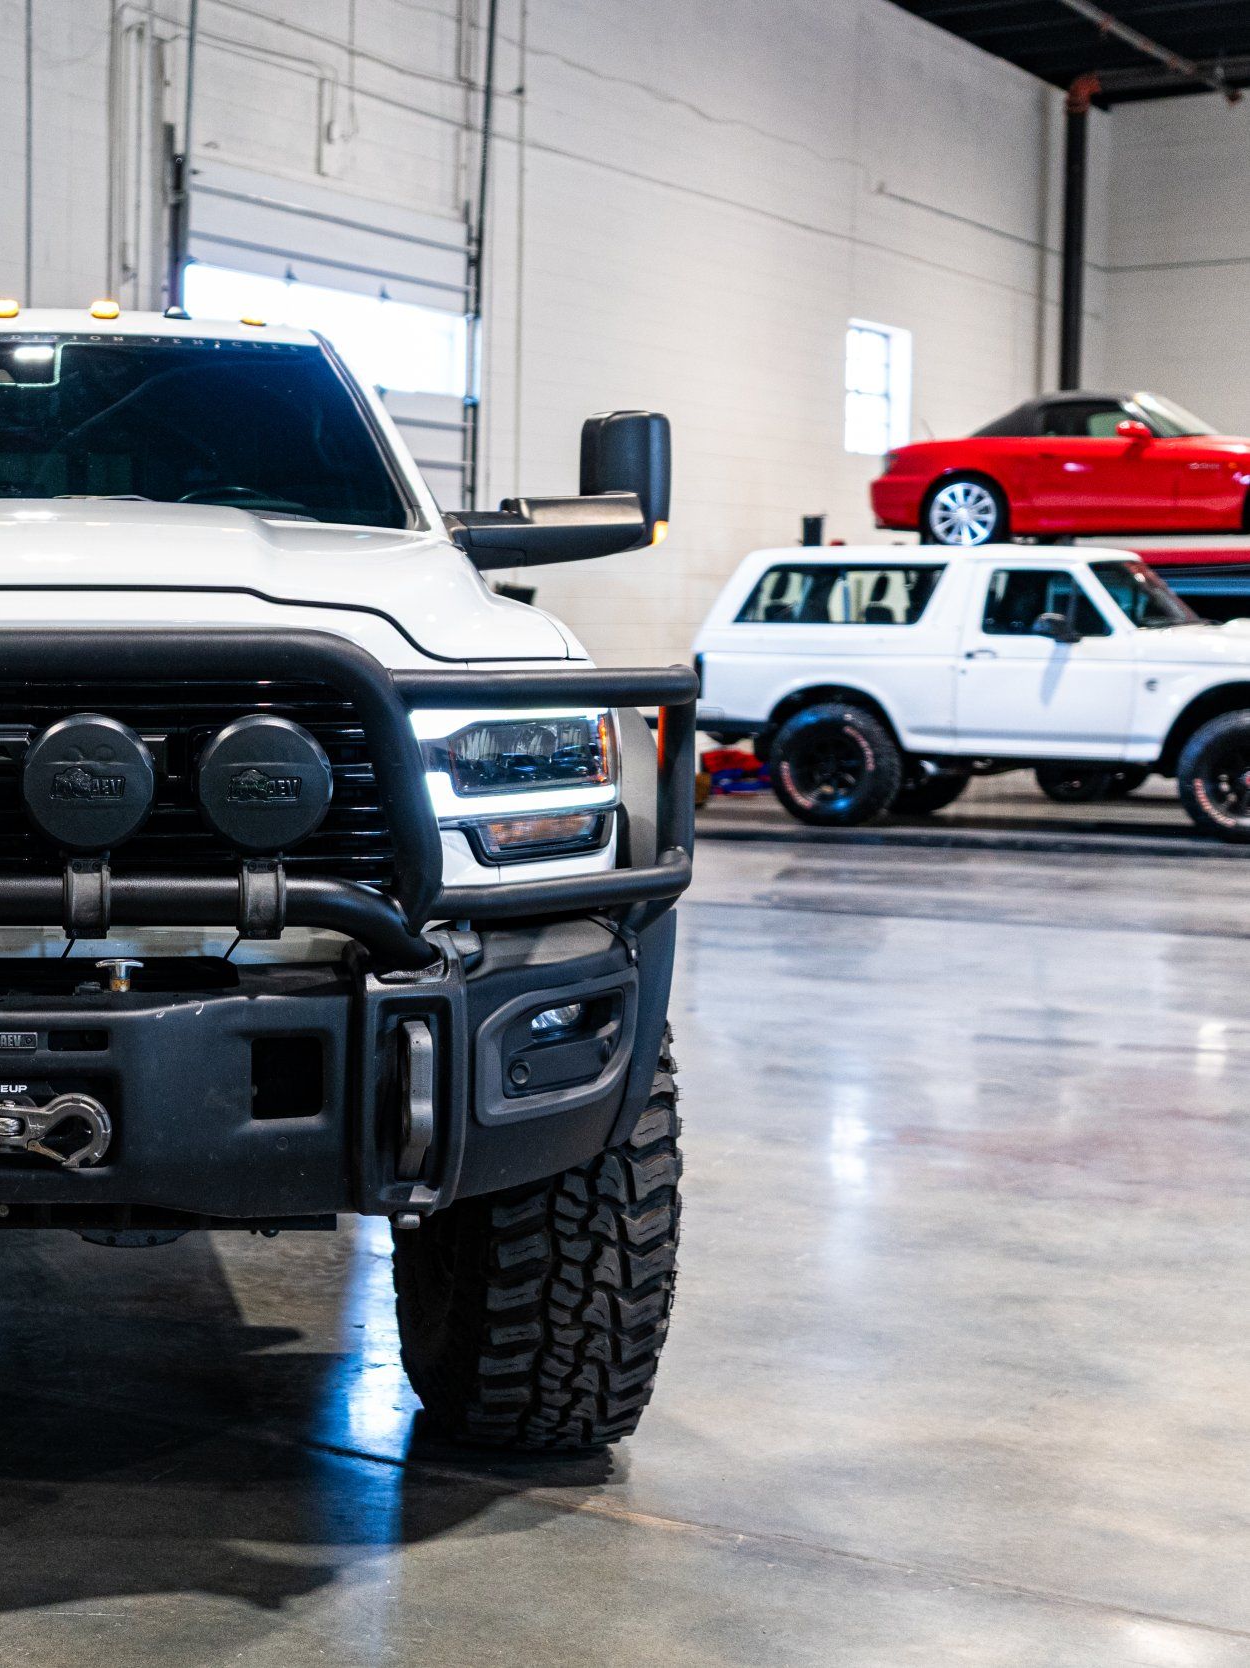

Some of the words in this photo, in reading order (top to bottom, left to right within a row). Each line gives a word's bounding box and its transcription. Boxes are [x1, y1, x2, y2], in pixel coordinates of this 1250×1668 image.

[150, 337, 299, 351] VEHICLES
[90, 778, 122, 795] AEV
[0, 1034, 21, 1047] AEV
